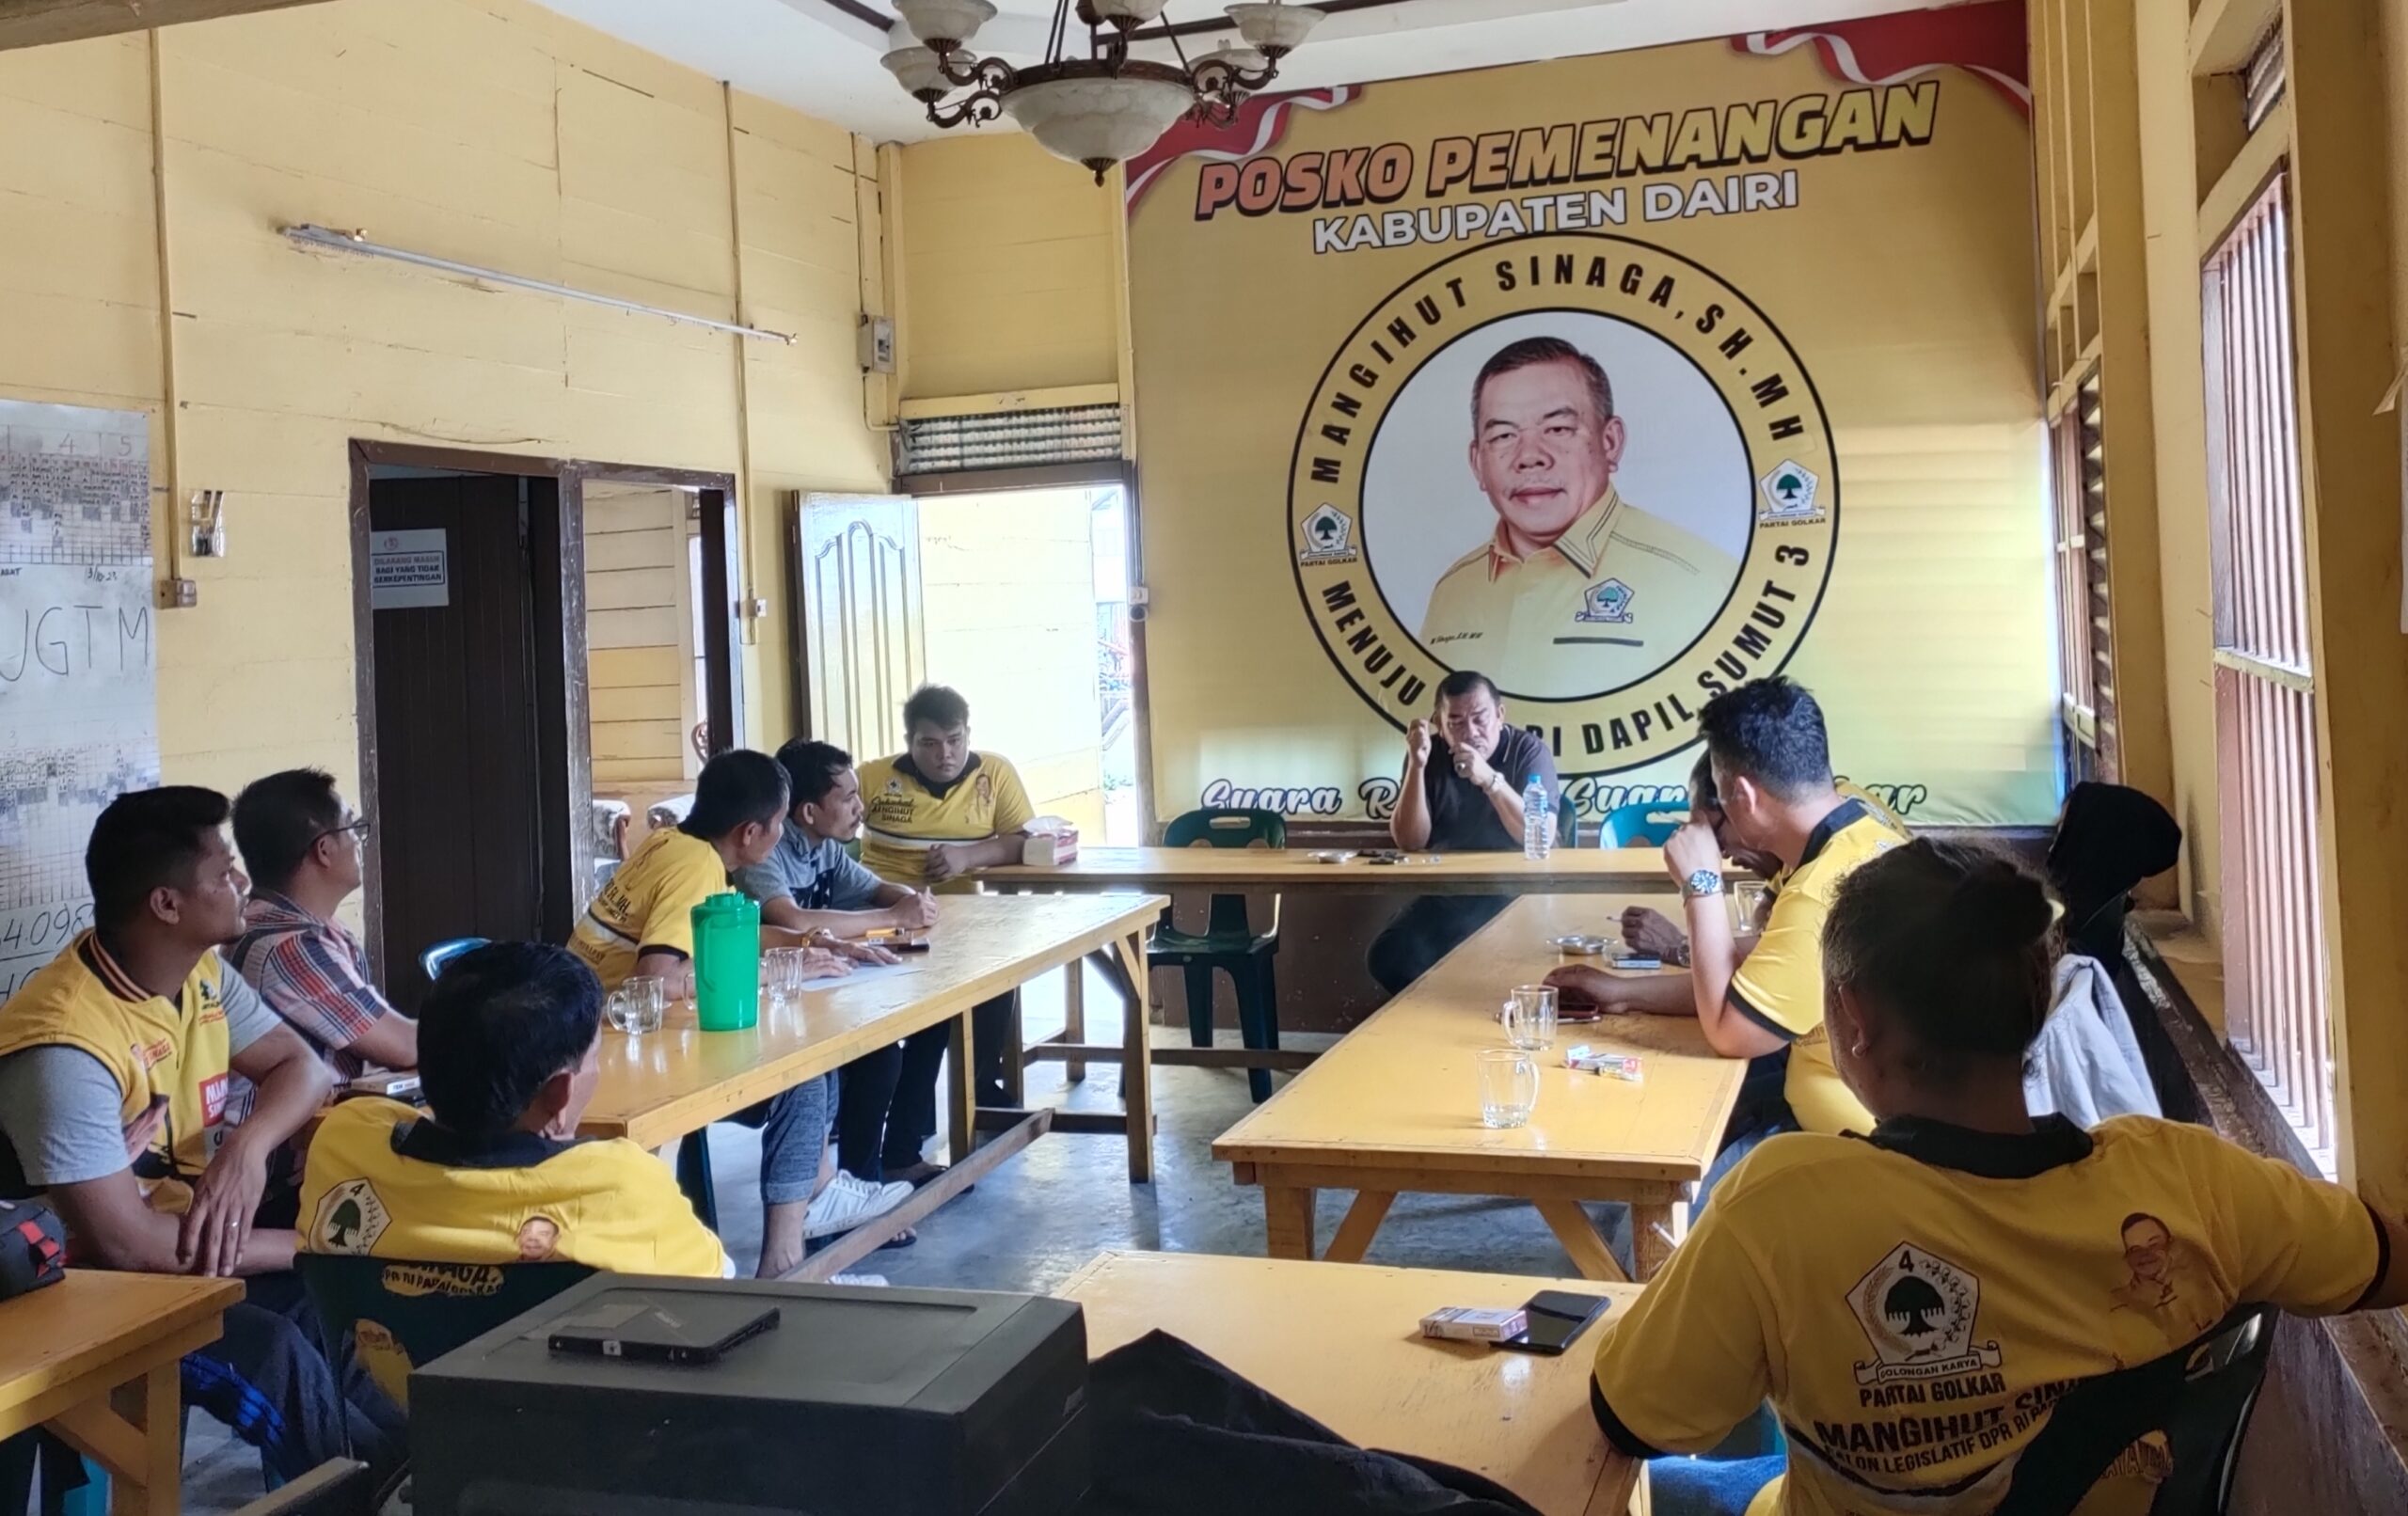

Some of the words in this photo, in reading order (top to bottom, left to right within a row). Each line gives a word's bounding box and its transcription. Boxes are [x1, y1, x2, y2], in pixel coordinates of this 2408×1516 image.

[1195, 142, 1414, 221] POSKO
[1425, 80, 1940, 198] PEMENANGAN
[1313, 188, 1626, 254] KABUPATEN
[1642, 169, 1798, 222] DAIRI
[1310, 276, 1467, 484] MANGIHUT
[1774, 544, 1810, 567] 3
[1322, 579, 1427, 706] MENUJU
[1581, 693, 1695, 755] DAPIL
[1697, 579, 1797, 699] SUMUT
[1201, 778, 1342, 815] Suara
[349, 1182, 365, 1197] 4
[1898, 1250, 1915, 1273] 4
[1941, 1358, 1978, 1372] KARYA
[1859, 1383, 1926, 1409] PARTAI
[1930, 1372, 2006, 1402] GOLKAR
[1814, 1406, 2004, 1454] MANGIHUT
[1883, 1436, 1975, 1474] LEGISLATIF
[1981, 1423, 2013, 1452] DPR
[2013, 1412, 2031, 1435] RI
